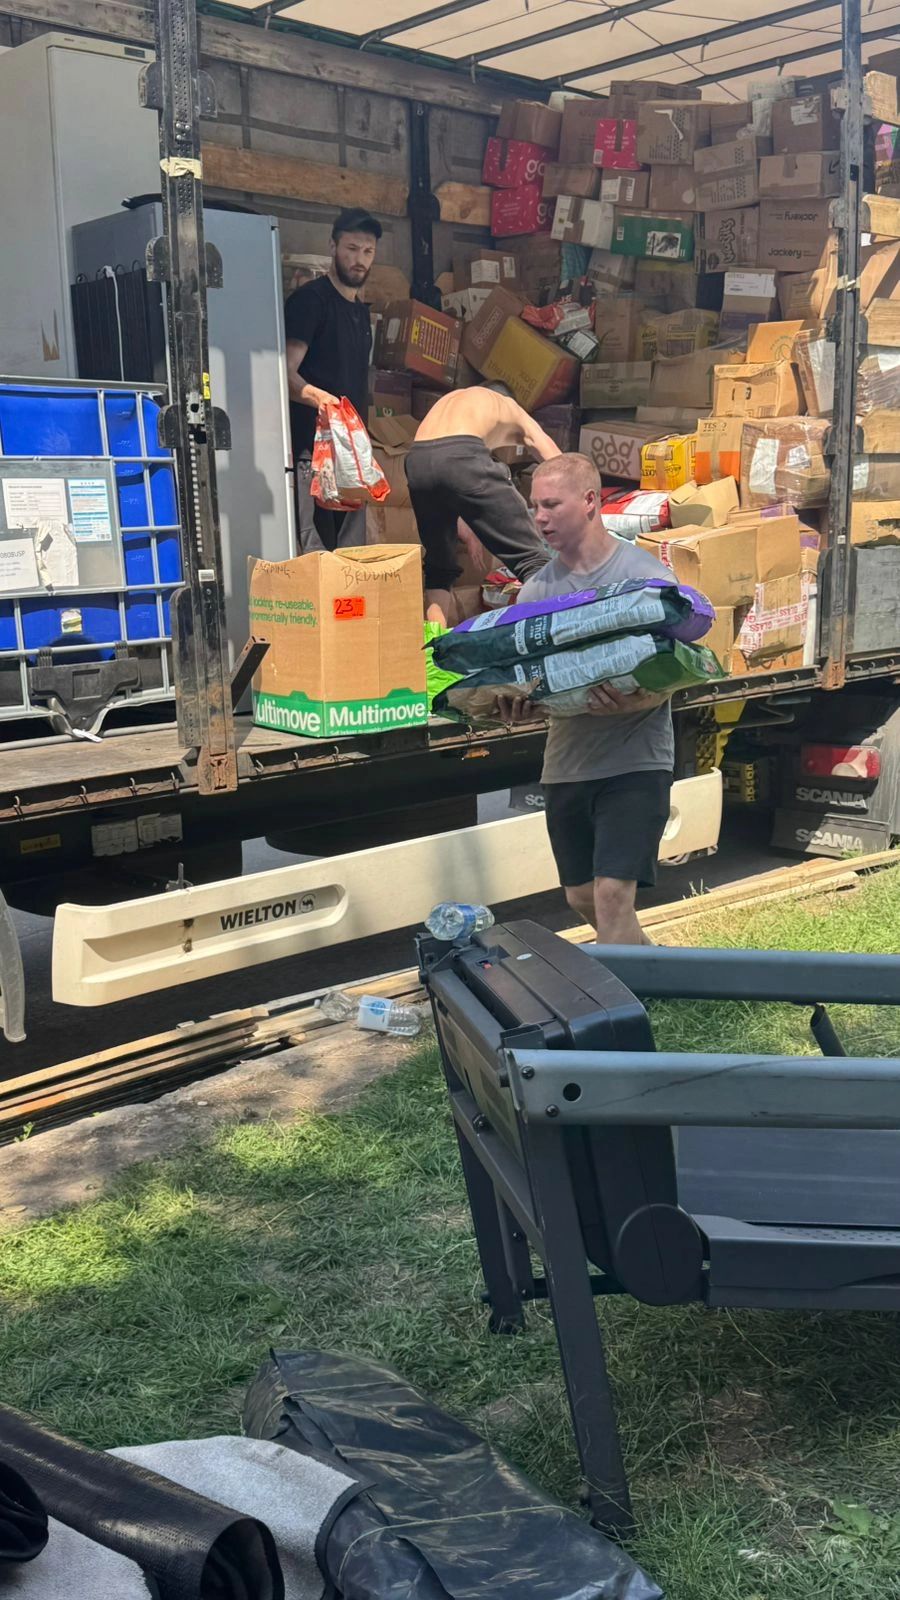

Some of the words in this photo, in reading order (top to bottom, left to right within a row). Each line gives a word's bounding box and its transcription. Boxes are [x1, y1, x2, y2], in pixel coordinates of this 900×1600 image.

[768, 248, 802, 259] Jackery
[591, 434, 635, 460] odd
[591, 450, 633, 477] box
[335, 598, 354, 615] 23
[330, 703, 426, 727] Multimove
[795, 787, 867, 809] SCANIA
[795, 828, 863, 850] SCANIA
[220, 899, 297, 930] WIELTON
